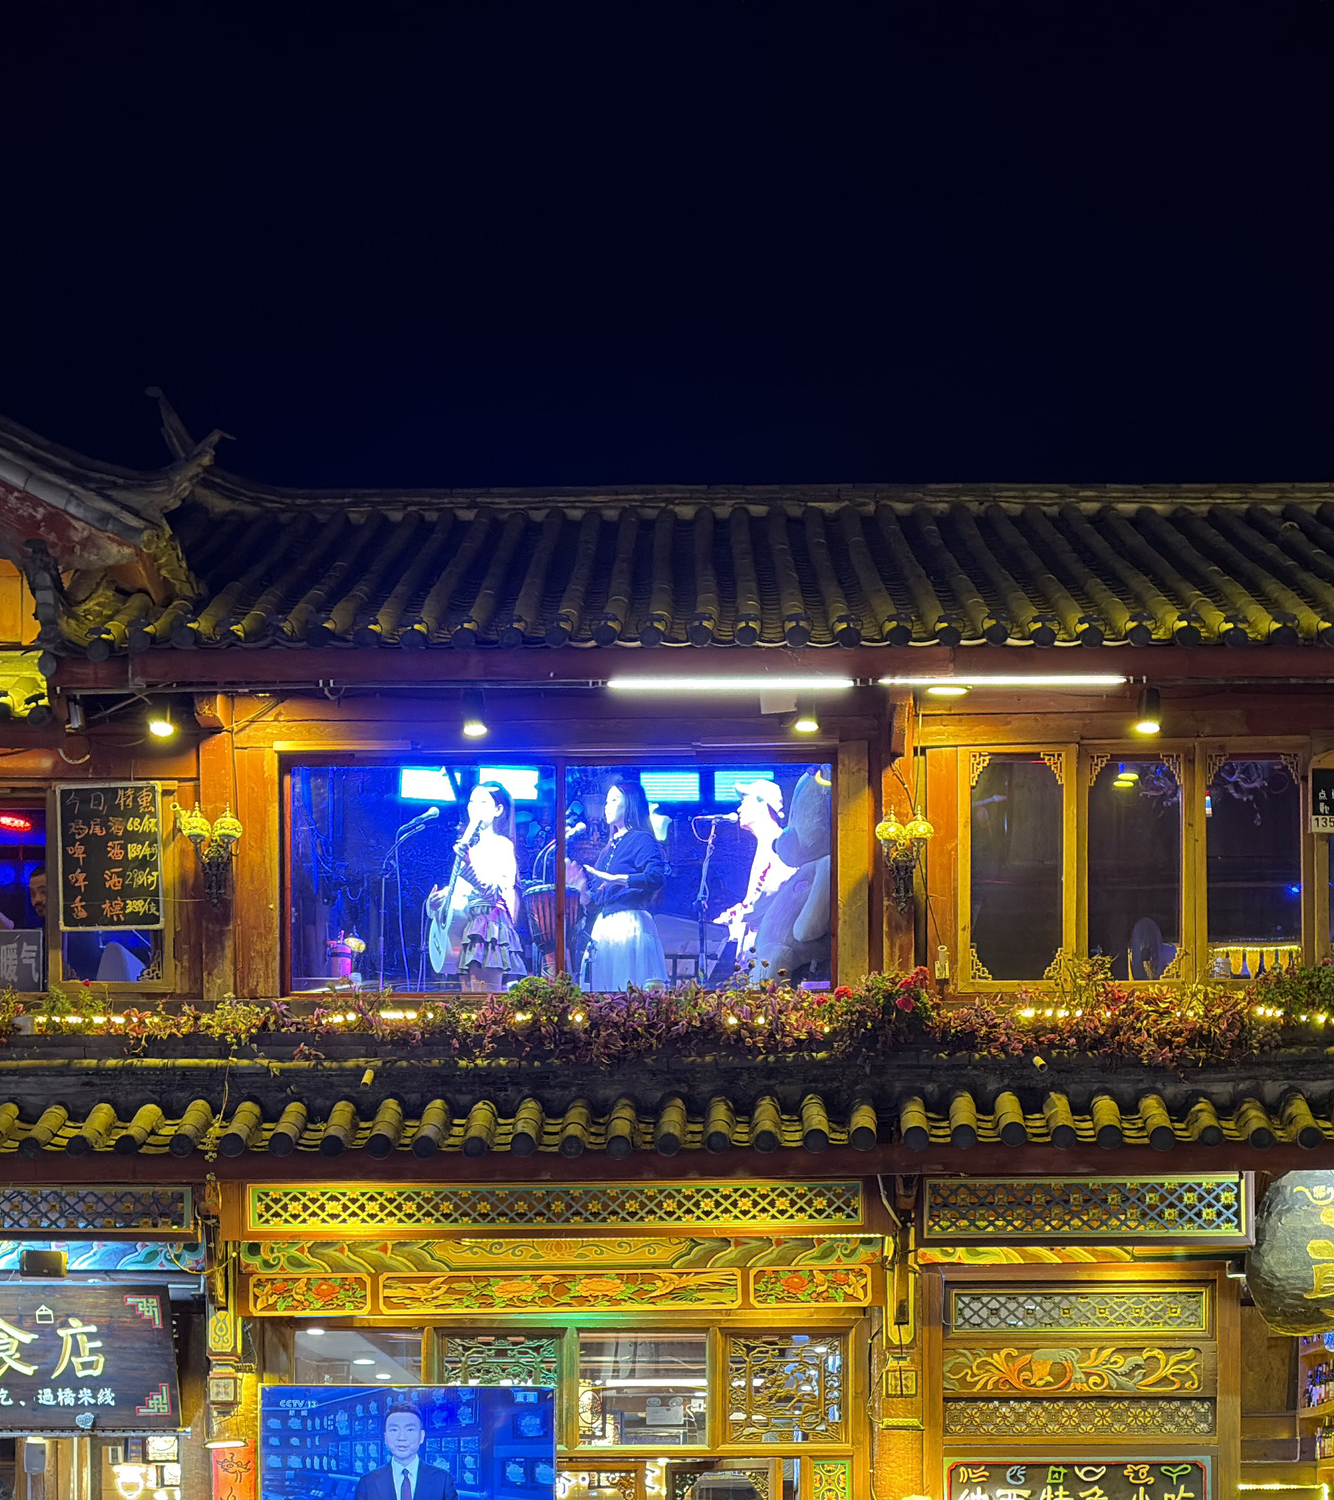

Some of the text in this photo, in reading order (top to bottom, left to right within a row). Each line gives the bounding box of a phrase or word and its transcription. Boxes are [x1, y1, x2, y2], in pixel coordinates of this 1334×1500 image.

[67, 841, 125, 866] 啤酒
[68, 868, 124, 893] 啤酒
[279, 1400, 305, 1408] CCTV
